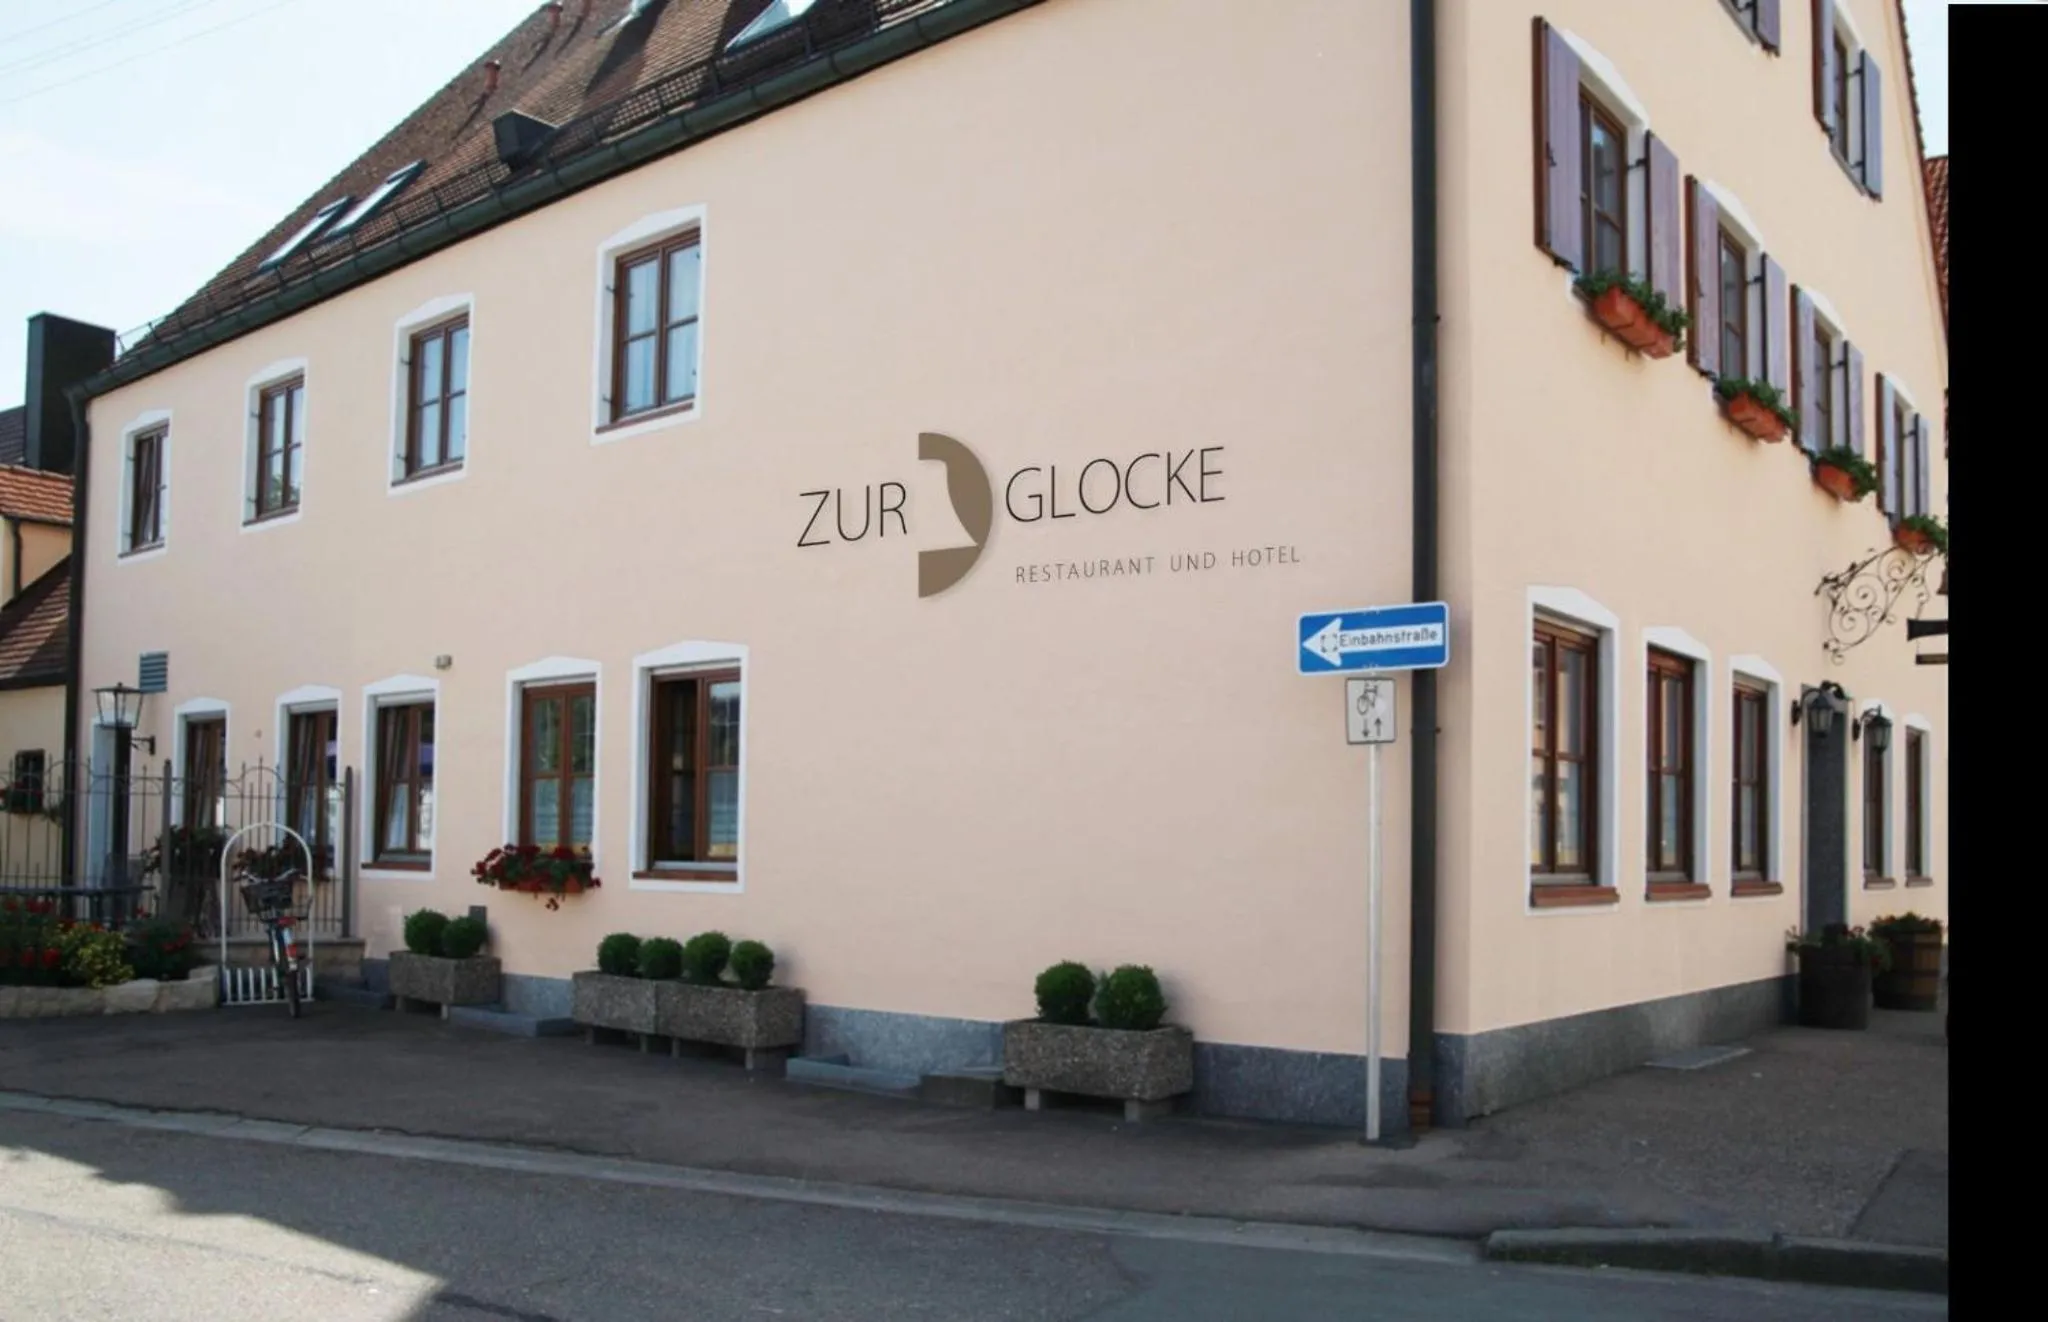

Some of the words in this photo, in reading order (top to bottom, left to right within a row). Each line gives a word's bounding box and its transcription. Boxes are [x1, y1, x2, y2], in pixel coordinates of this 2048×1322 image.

[797, 482, 907, 547] ZUR
[1006, 446, 1226, 522] GLOCKE
[1016, 556, 1155, 583] RESTAURANT
[1170, 552, 1216, 573] UND
[1232, 545, 1301, 567] HOTEL
[1339, 627, 1438, 648] Einbahnstraße
